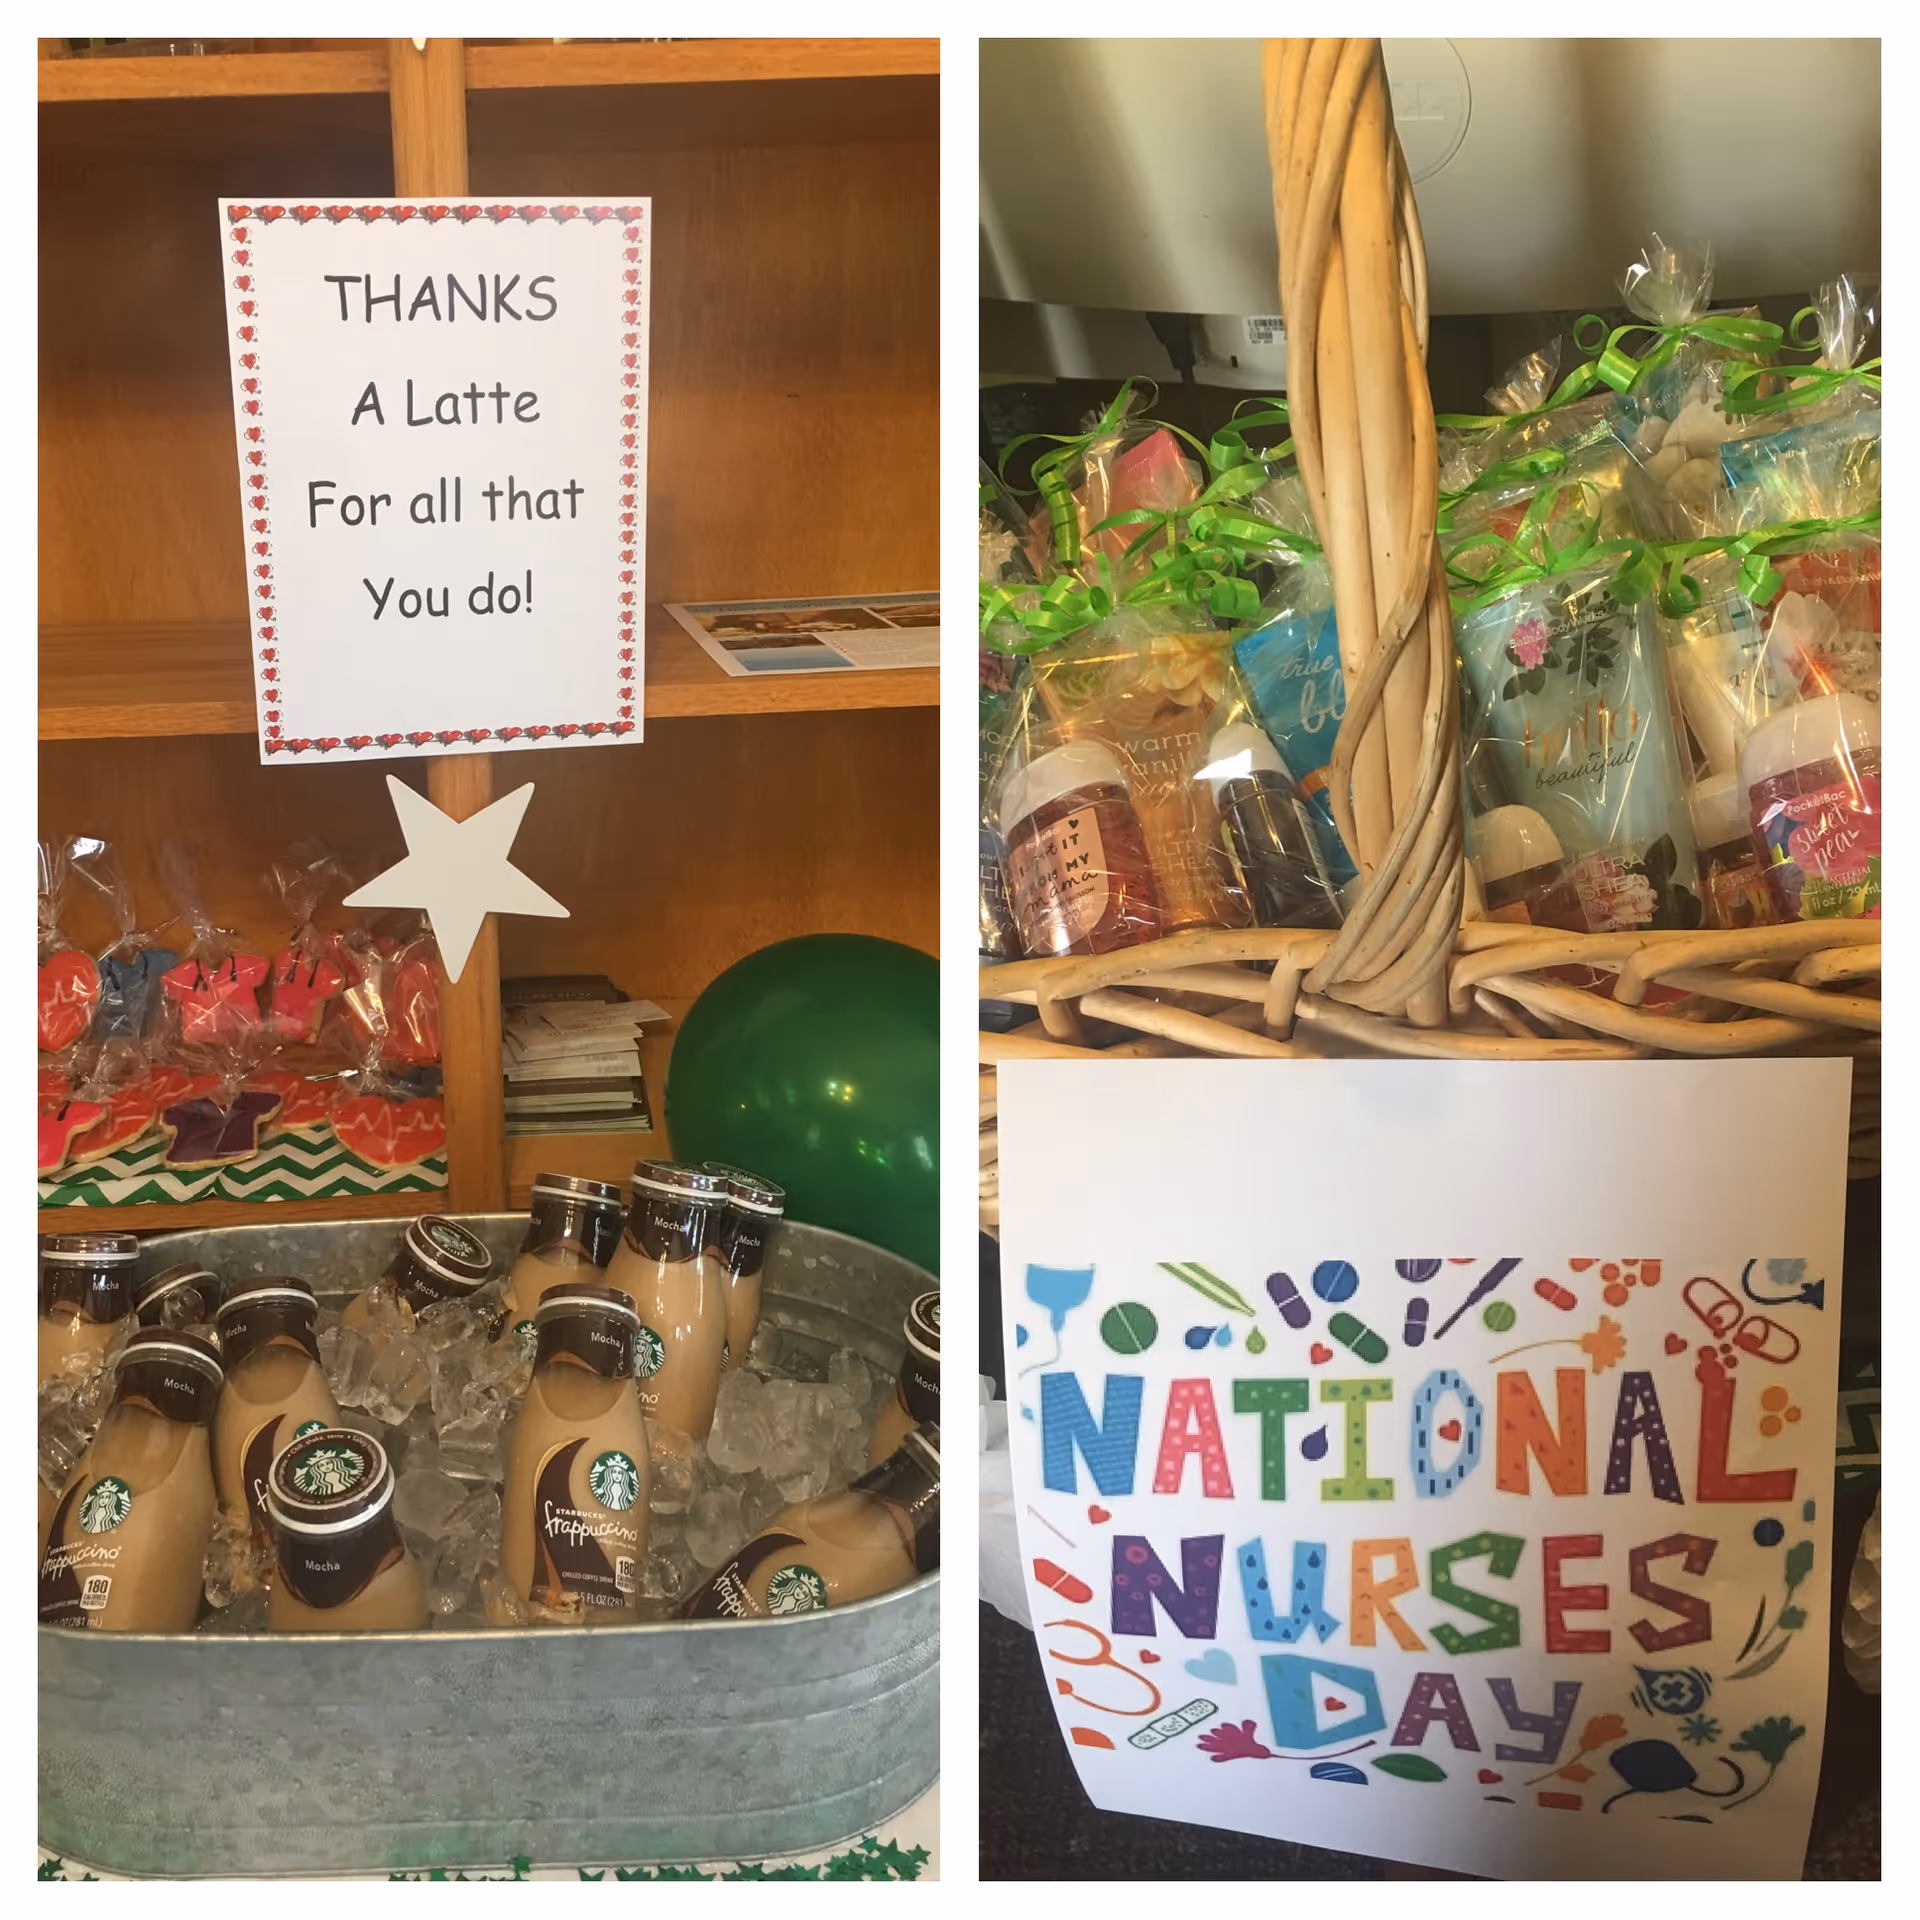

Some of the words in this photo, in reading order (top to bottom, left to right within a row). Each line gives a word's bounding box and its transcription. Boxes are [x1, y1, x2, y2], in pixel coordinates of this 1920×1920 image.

[324, 274, 559, 323] THANKS
[351, 381, 385, 425] A
[406, 378, 541, 427] Latte
[307, 480, 392, 528] For
[409, 476, 462, 525] all
[482, 475, 585, 521] that
[362, 577, 450, 621] You
[468, 569, 533, 615] do!
[1281, 654, 1335, 679] true
[1116, 730, 1201, 754] warm
[1535, 741, 1636, 790] beautiful
[1787, 790, 1846, 815] PocketBac
[1062, 833, 1079, 849] IT
[1066, 852, 1089, 872] MY
[1581, 873, 1645, 901] SHEA
[654, 1216, 686, 1233] Mocha
[414, 1279, 440, 1299] Mocha
[591, 1332, 621, 1348] Mocha
[164, 1377, 196, 1396] Mocha
[914, 1372, 940, 1394] Moch
[1039, 1367, 1798, 1505] NATIONAL
[545, 1500, 637, 1547] frappuccino
[556, 1508, 605, 1519] STARBUCKS
[41, 1543, 121, 1582] frappuccino
[305, 1559, 341, 1572] Mocha
[619, 1559, 634, 1578] 180
[87, 1579, 109, 1594] 180
[1109, 1529, 1719, 1655] NURSES
[1260, 1652, 1583, 1765] DAY
